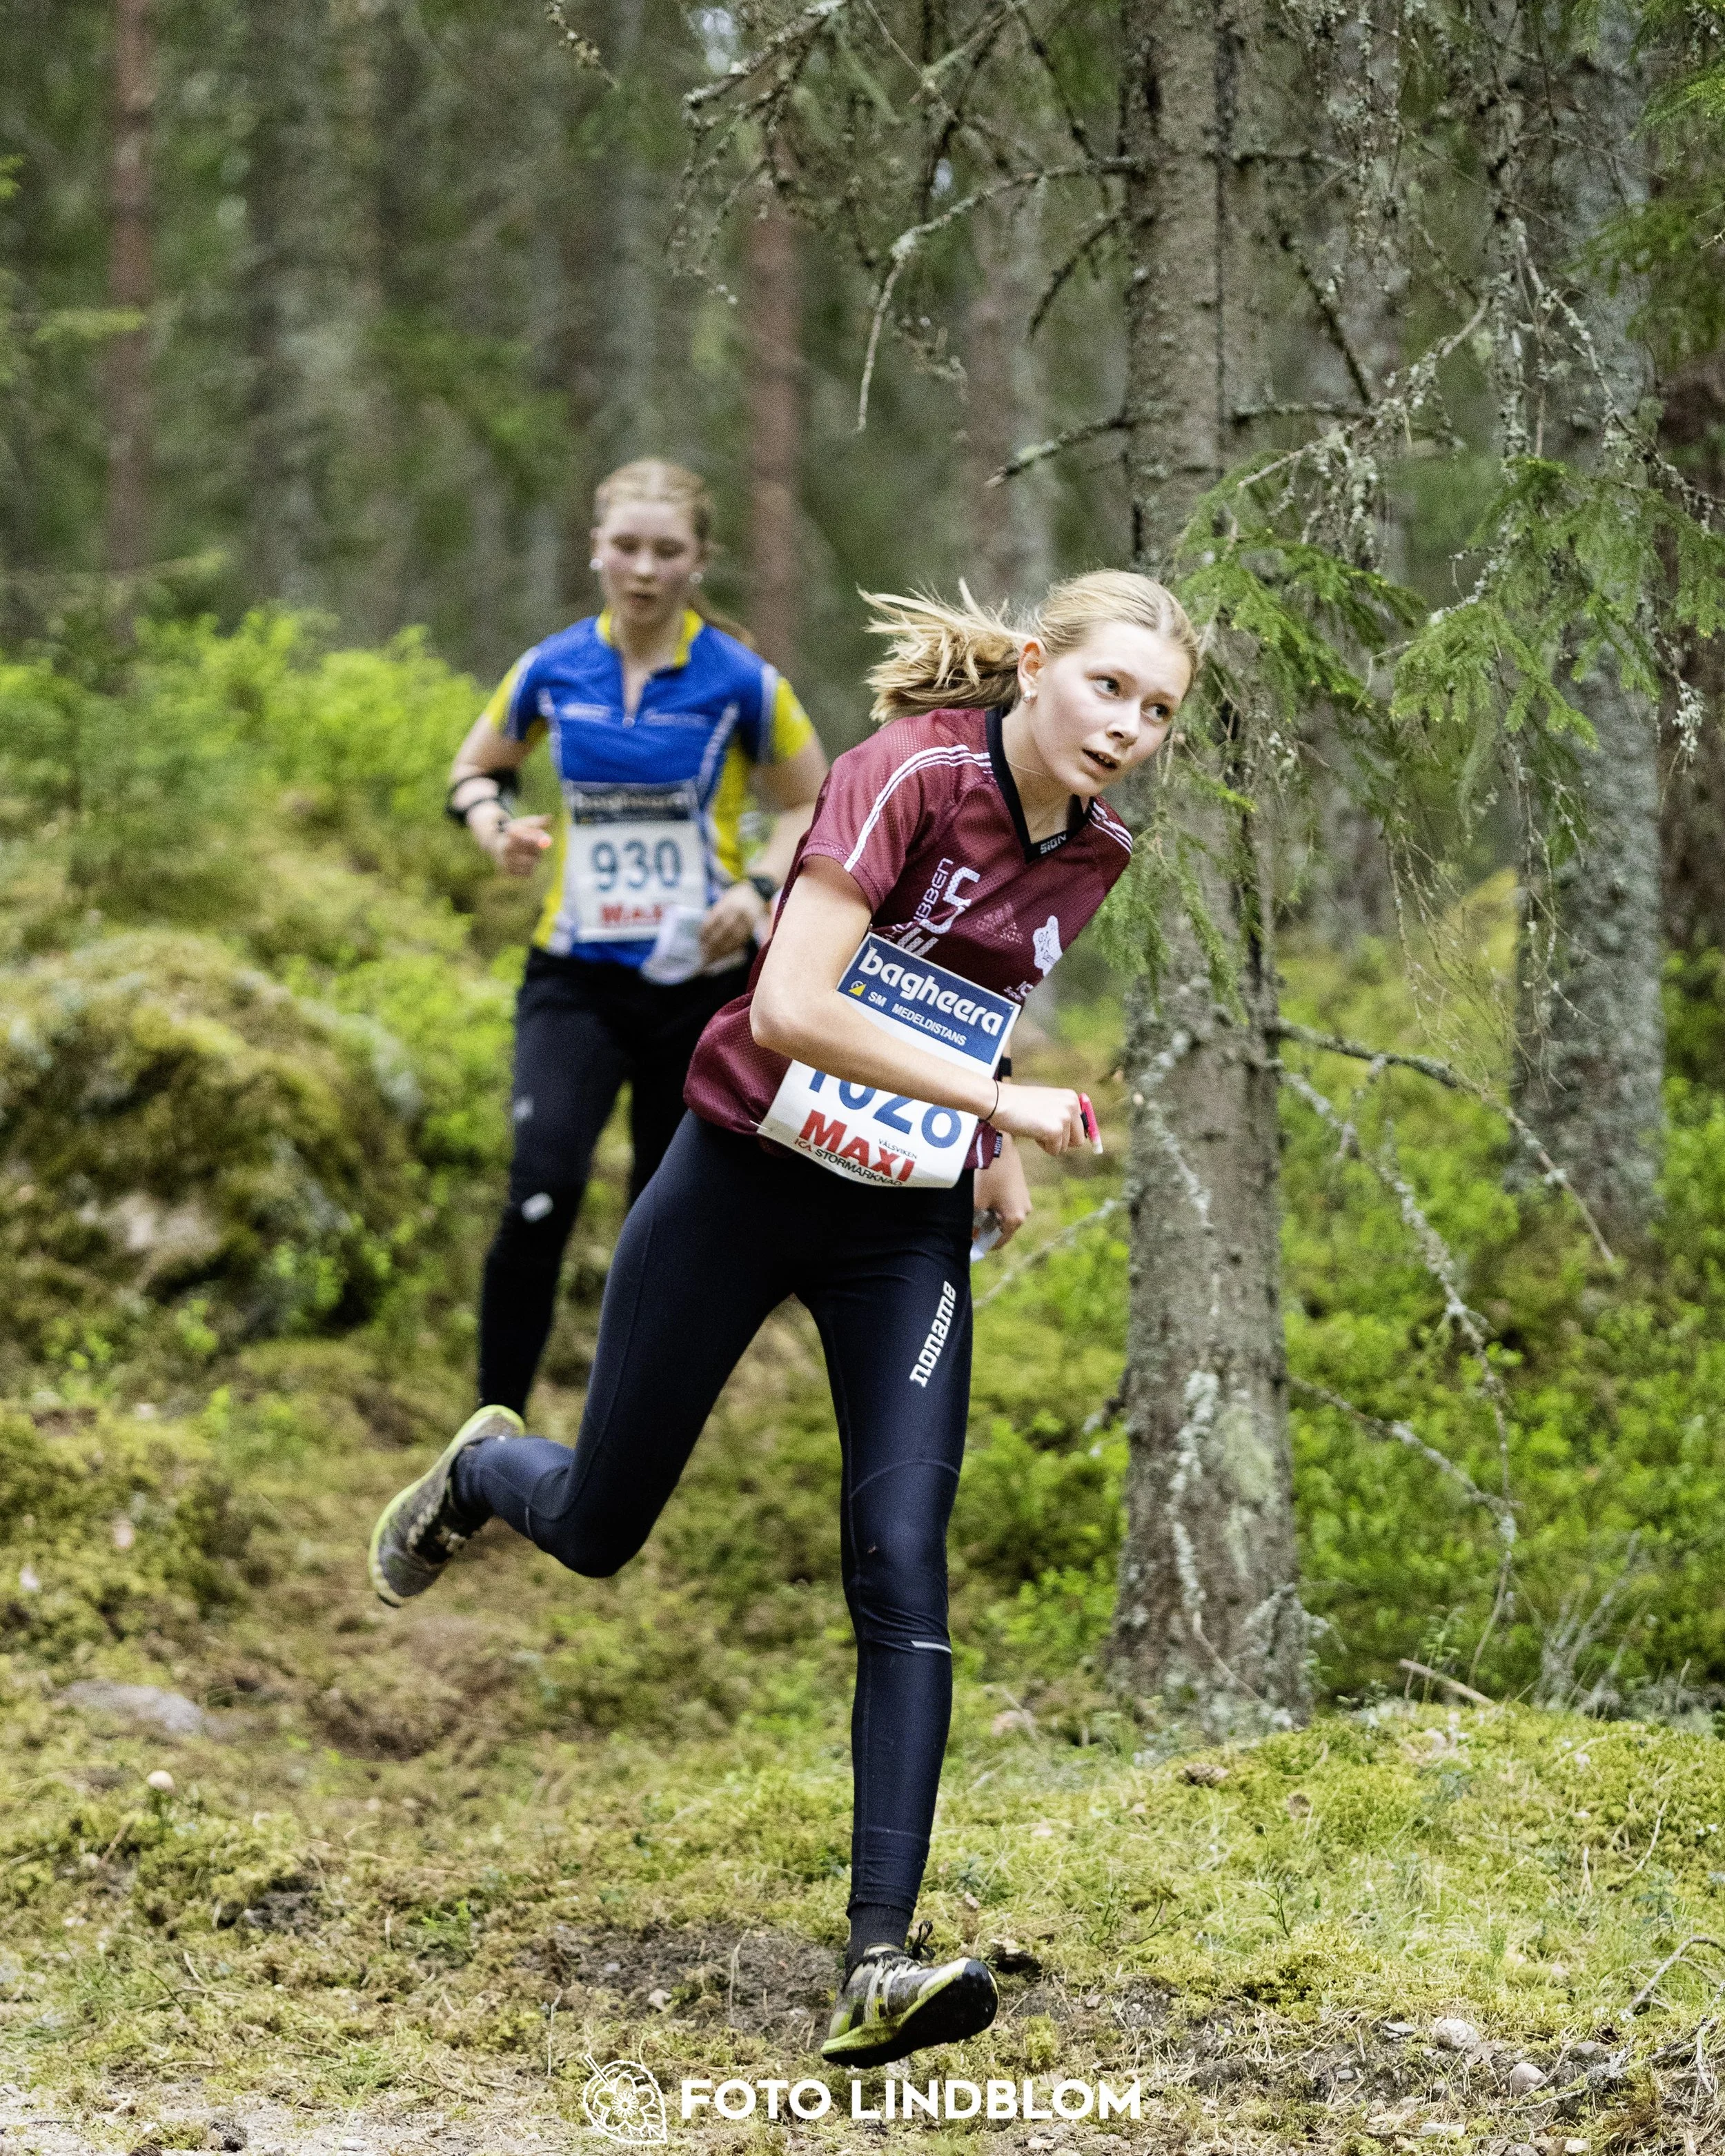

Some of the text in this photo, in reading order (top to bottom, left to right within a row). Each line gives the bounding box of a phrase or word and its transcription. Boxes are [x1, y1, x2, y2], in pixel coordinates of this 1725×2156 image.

[591, 839, 682, 891] 930
[858, 947, 1004, 1036] bagheera
[868, 991, 967, 1047] SM MEDELDISTANS
[798, 1109, 915, 1182] MAXI
[809, 1070, 962, 1149] 28
[909, 1280, 956, 1387] noname
